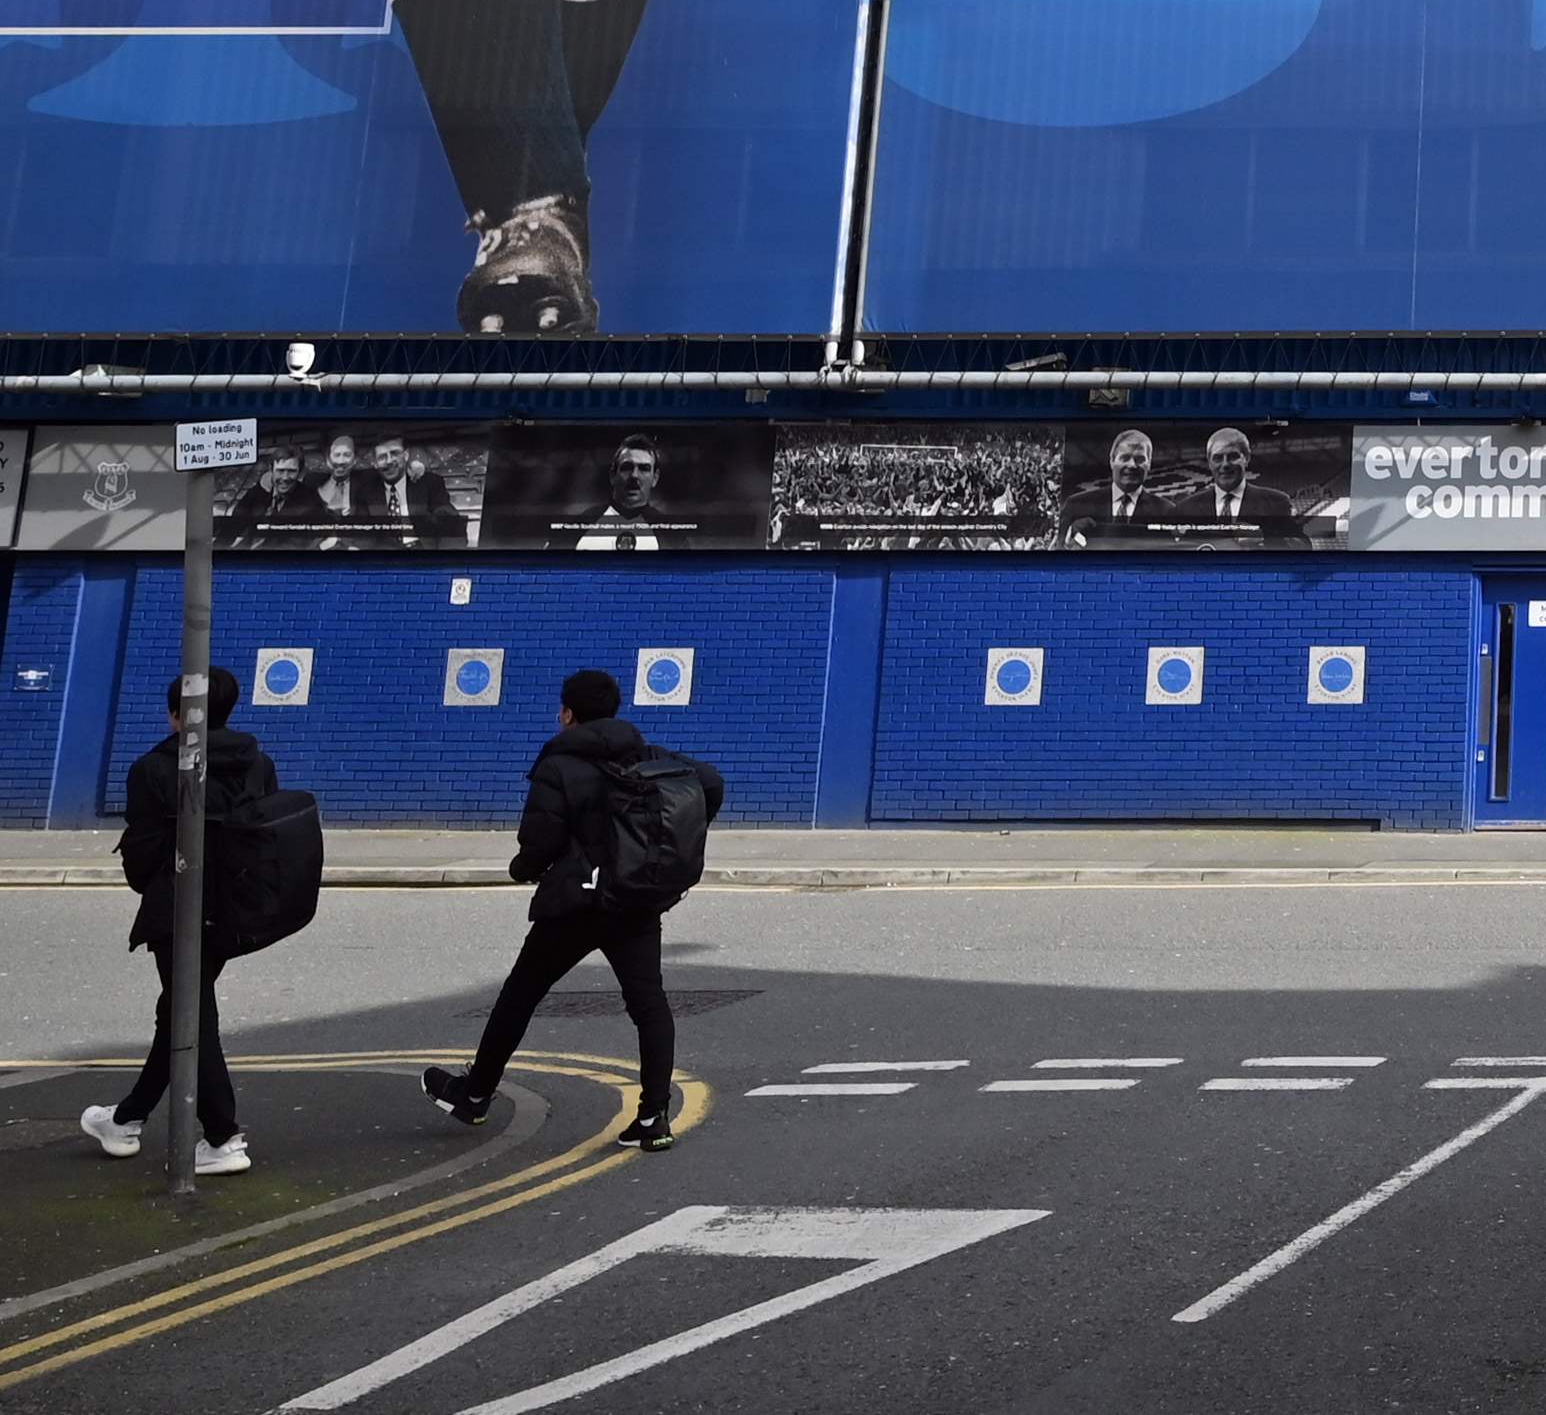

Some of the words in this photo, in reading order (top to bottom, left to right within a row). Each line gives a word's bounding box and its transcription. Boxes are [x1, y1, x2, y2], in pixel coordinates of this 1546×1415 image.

[192, 426, 206, 435] No
[208, 424, 242, 434] loading
[214, 438, 253, 449] Midnight
[191, 455, 209, 464] Aug
[219, 452, 232, 461] 30
[235, 451, 250, 460] Jun
